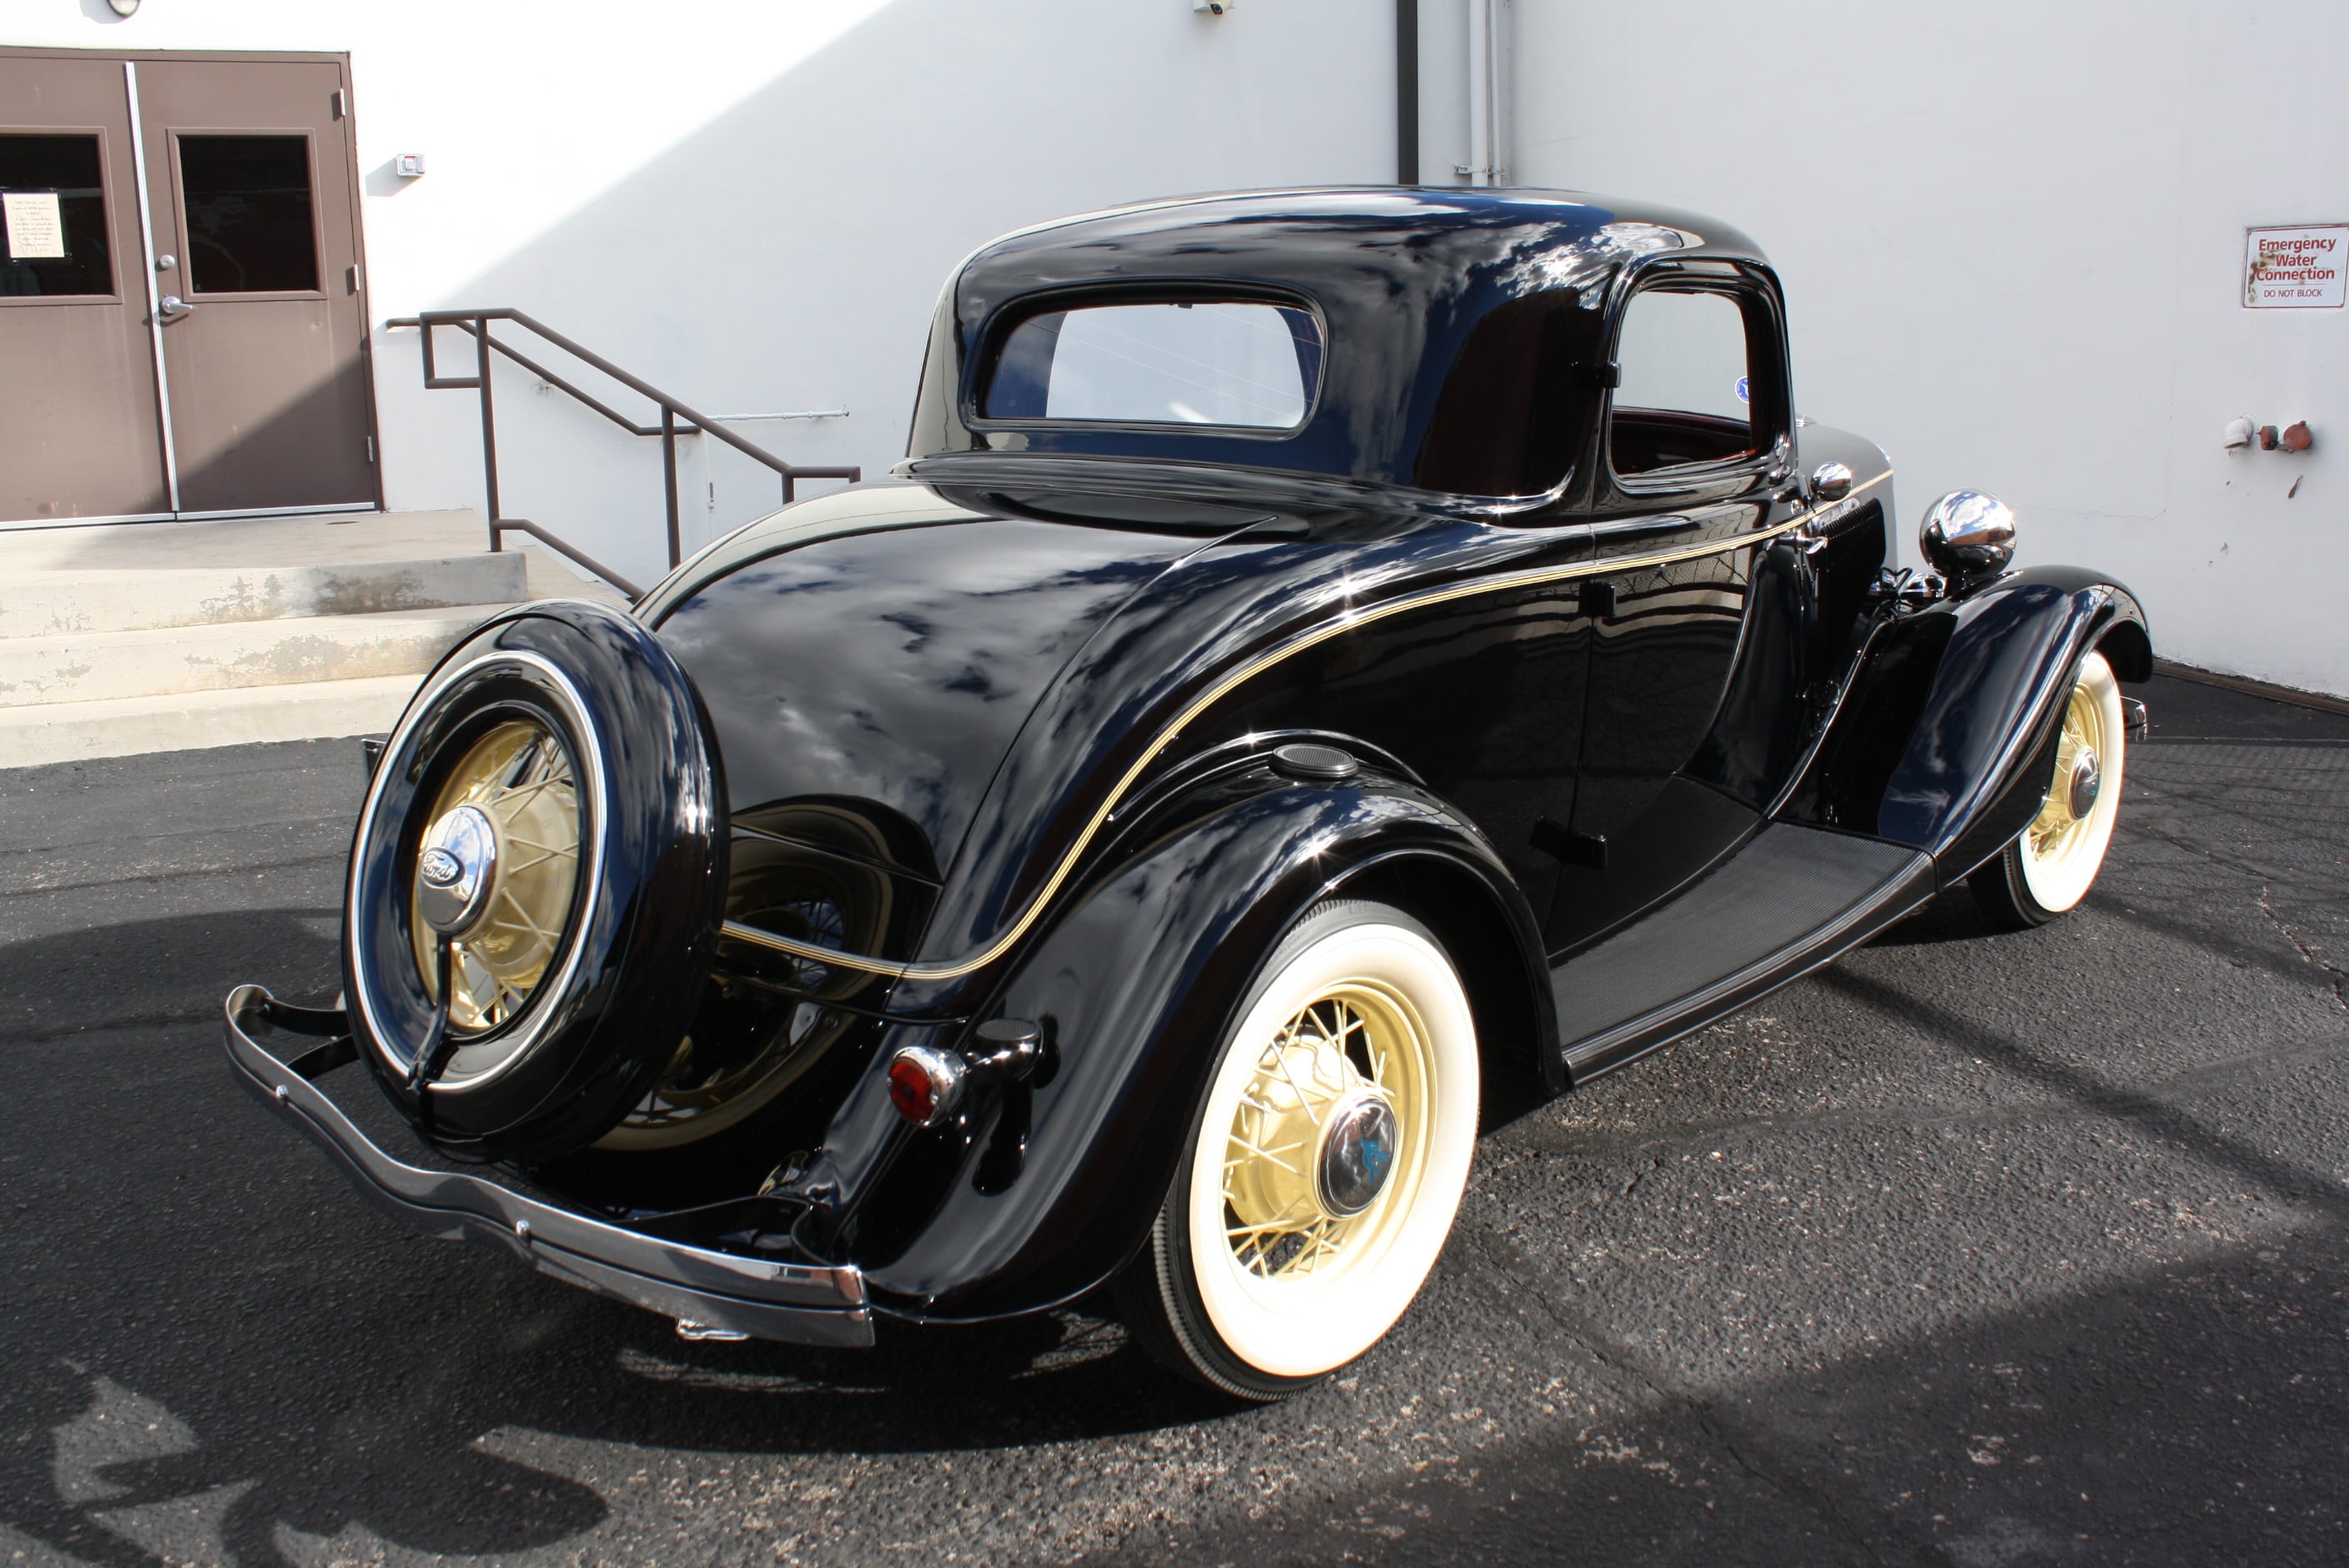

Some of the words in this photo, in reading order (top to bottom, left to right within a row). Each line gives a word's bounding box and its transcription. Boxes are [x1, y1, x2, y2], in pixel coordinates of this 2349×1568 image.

[2259, 239, 2336, 253] Emergency
[2276, 254, 2316, 267] Water
[2256, 267, 2335, 281] Connection
[2297, 289, 2322, 297] BLOCK
[423, 852, 452, 880] Ford
